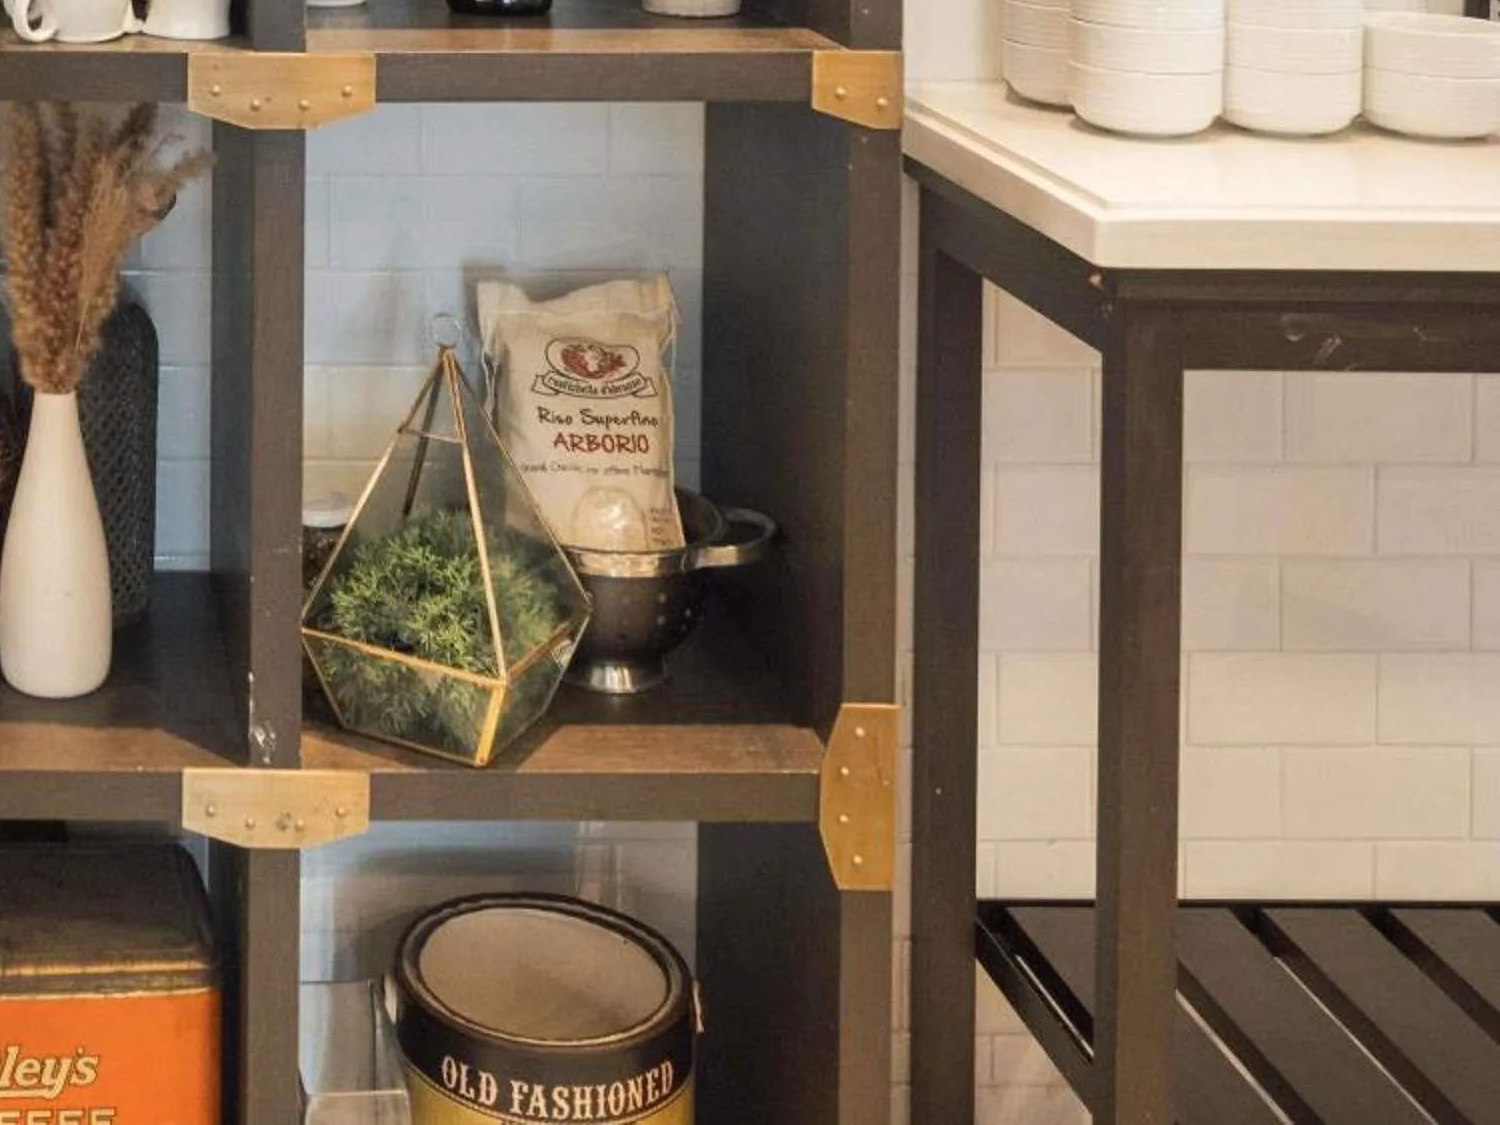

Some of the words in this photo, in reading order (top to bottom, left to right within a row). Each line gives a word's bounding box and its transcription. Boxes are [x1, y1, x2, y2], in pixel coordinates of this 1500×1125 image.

[536, 406, 573, 426] Riso
[579, 408, 659, 431] Superfino
[552, 432, 650, 454] ARBORIO
[441, 1055, 499, 1106] OLD
[508, 1060, 674, 1120] FASHIONED
